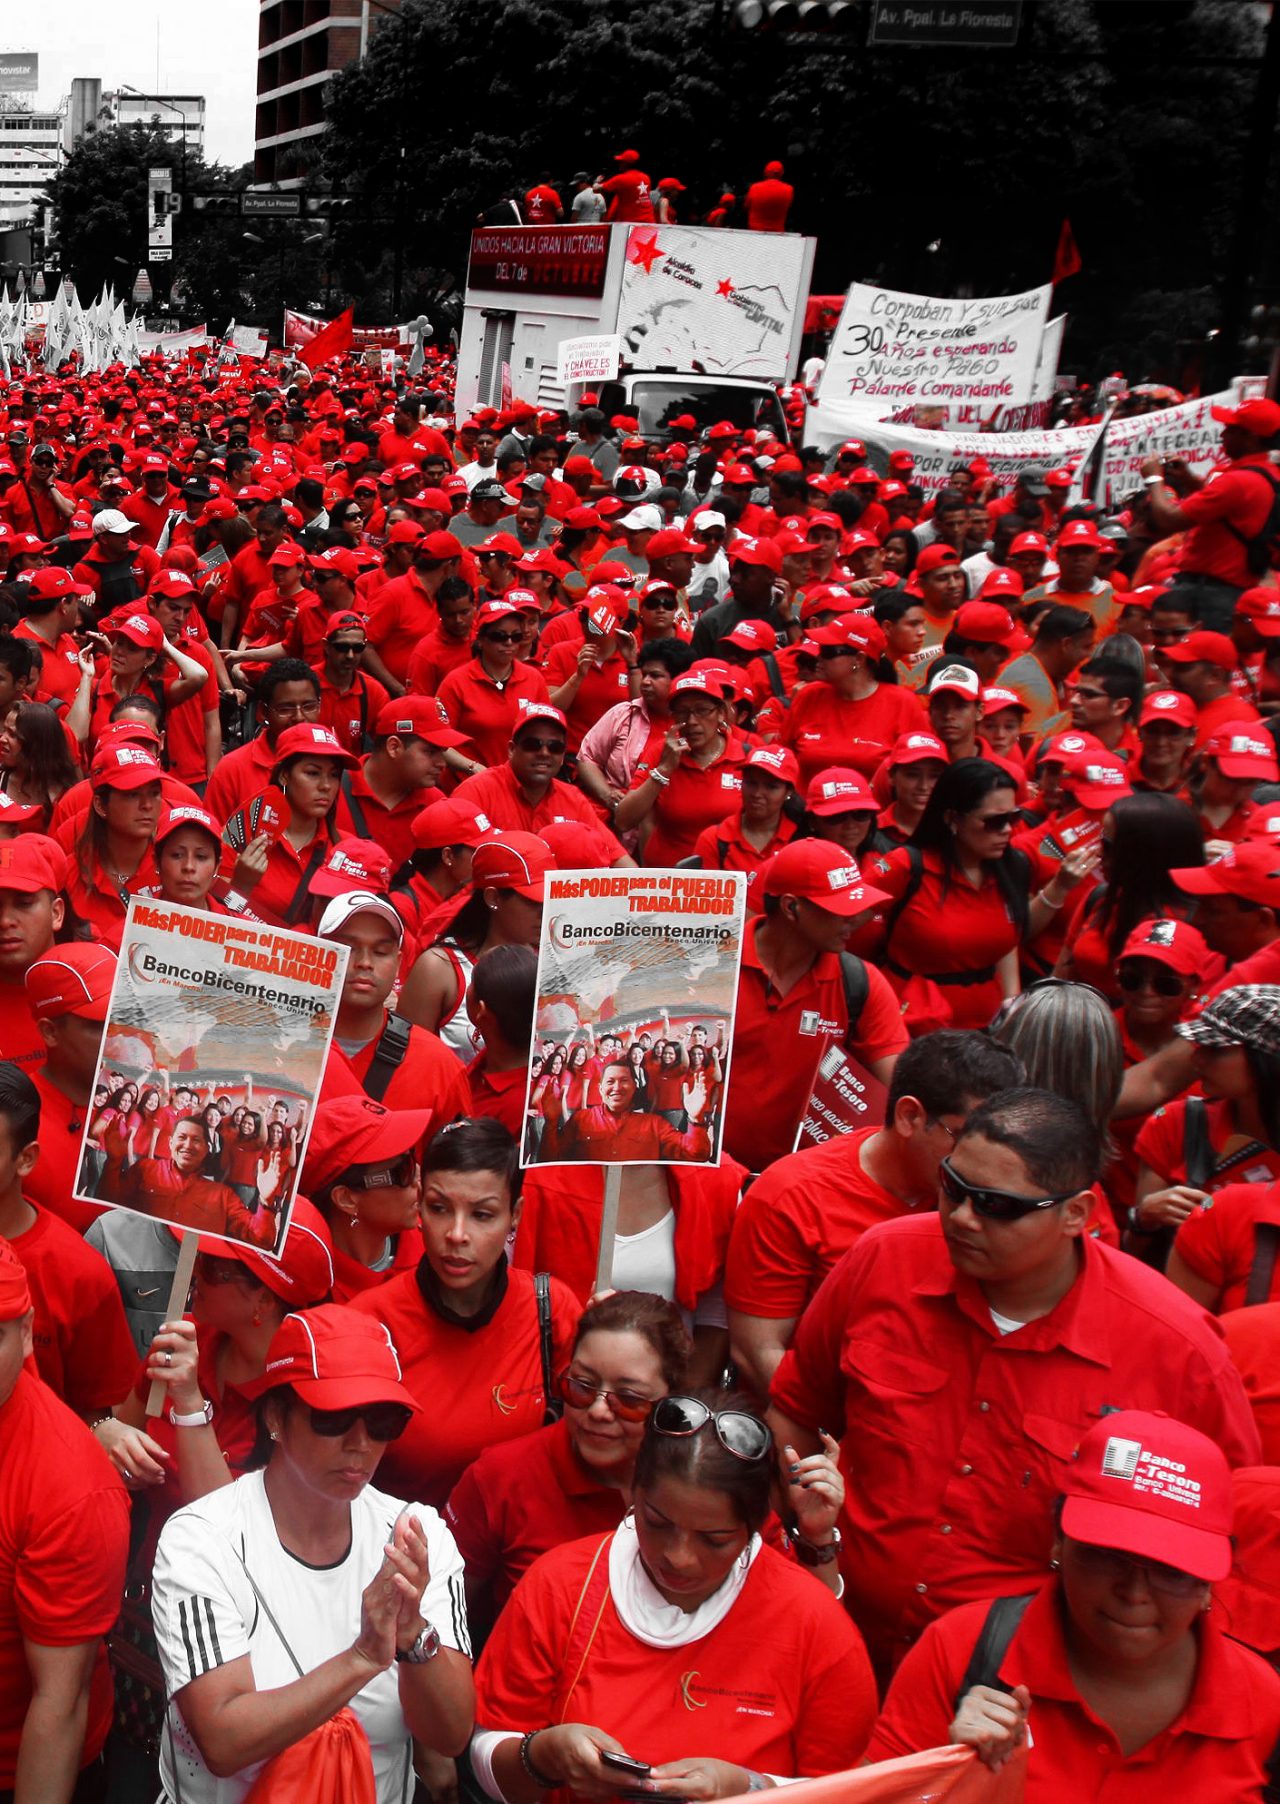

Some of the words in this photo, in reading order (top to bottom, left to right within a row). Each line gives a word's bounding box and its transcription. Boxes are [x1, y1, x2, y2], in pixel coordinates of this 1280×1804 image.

[879, 9, 902, 24] Av.
[906, 10, 937, 27] Ppal.
[961, 11, 1013, 27] Floresta
[473, 236, 500, 254] UNIDOS
[500, 236, 524, 254] HACIA
[525, 236, 536, 254] LA
[537, 235, 561, 254] GRAN
[563, 234, 604, 254] VICTORIA
[495, 262, 509, 280] DEL
[511, 262, 517, 280] 7
[517, 265, 528, 281] de
[744, 309, 785, 335] CAPITAL
[842, 324, 884, 355] 30
[932, 336, 1017, 358] esperando
[600, 358, 610, 368] ES
[920, 375, 1014, 398] Comandante
[671, 877, 737, 899] PUEBLO
[628, 895, 734, 915] TRABAJADOR
[562, 922, 732, 940] BancoBicentenario
[271, 936, 338, 971] PUEBLO
[223, 945, 333, 989] TRABAJADOR
[142, 954, 326, 1014] BancoBicentenario
[838, 1066, 866, 1093] Banco
[1140, 1451, 1186, 1472] Banco
[1134, 1476, 1164, 1489] Banco
[1147, 1464, 1201, 1492] Tesoro
